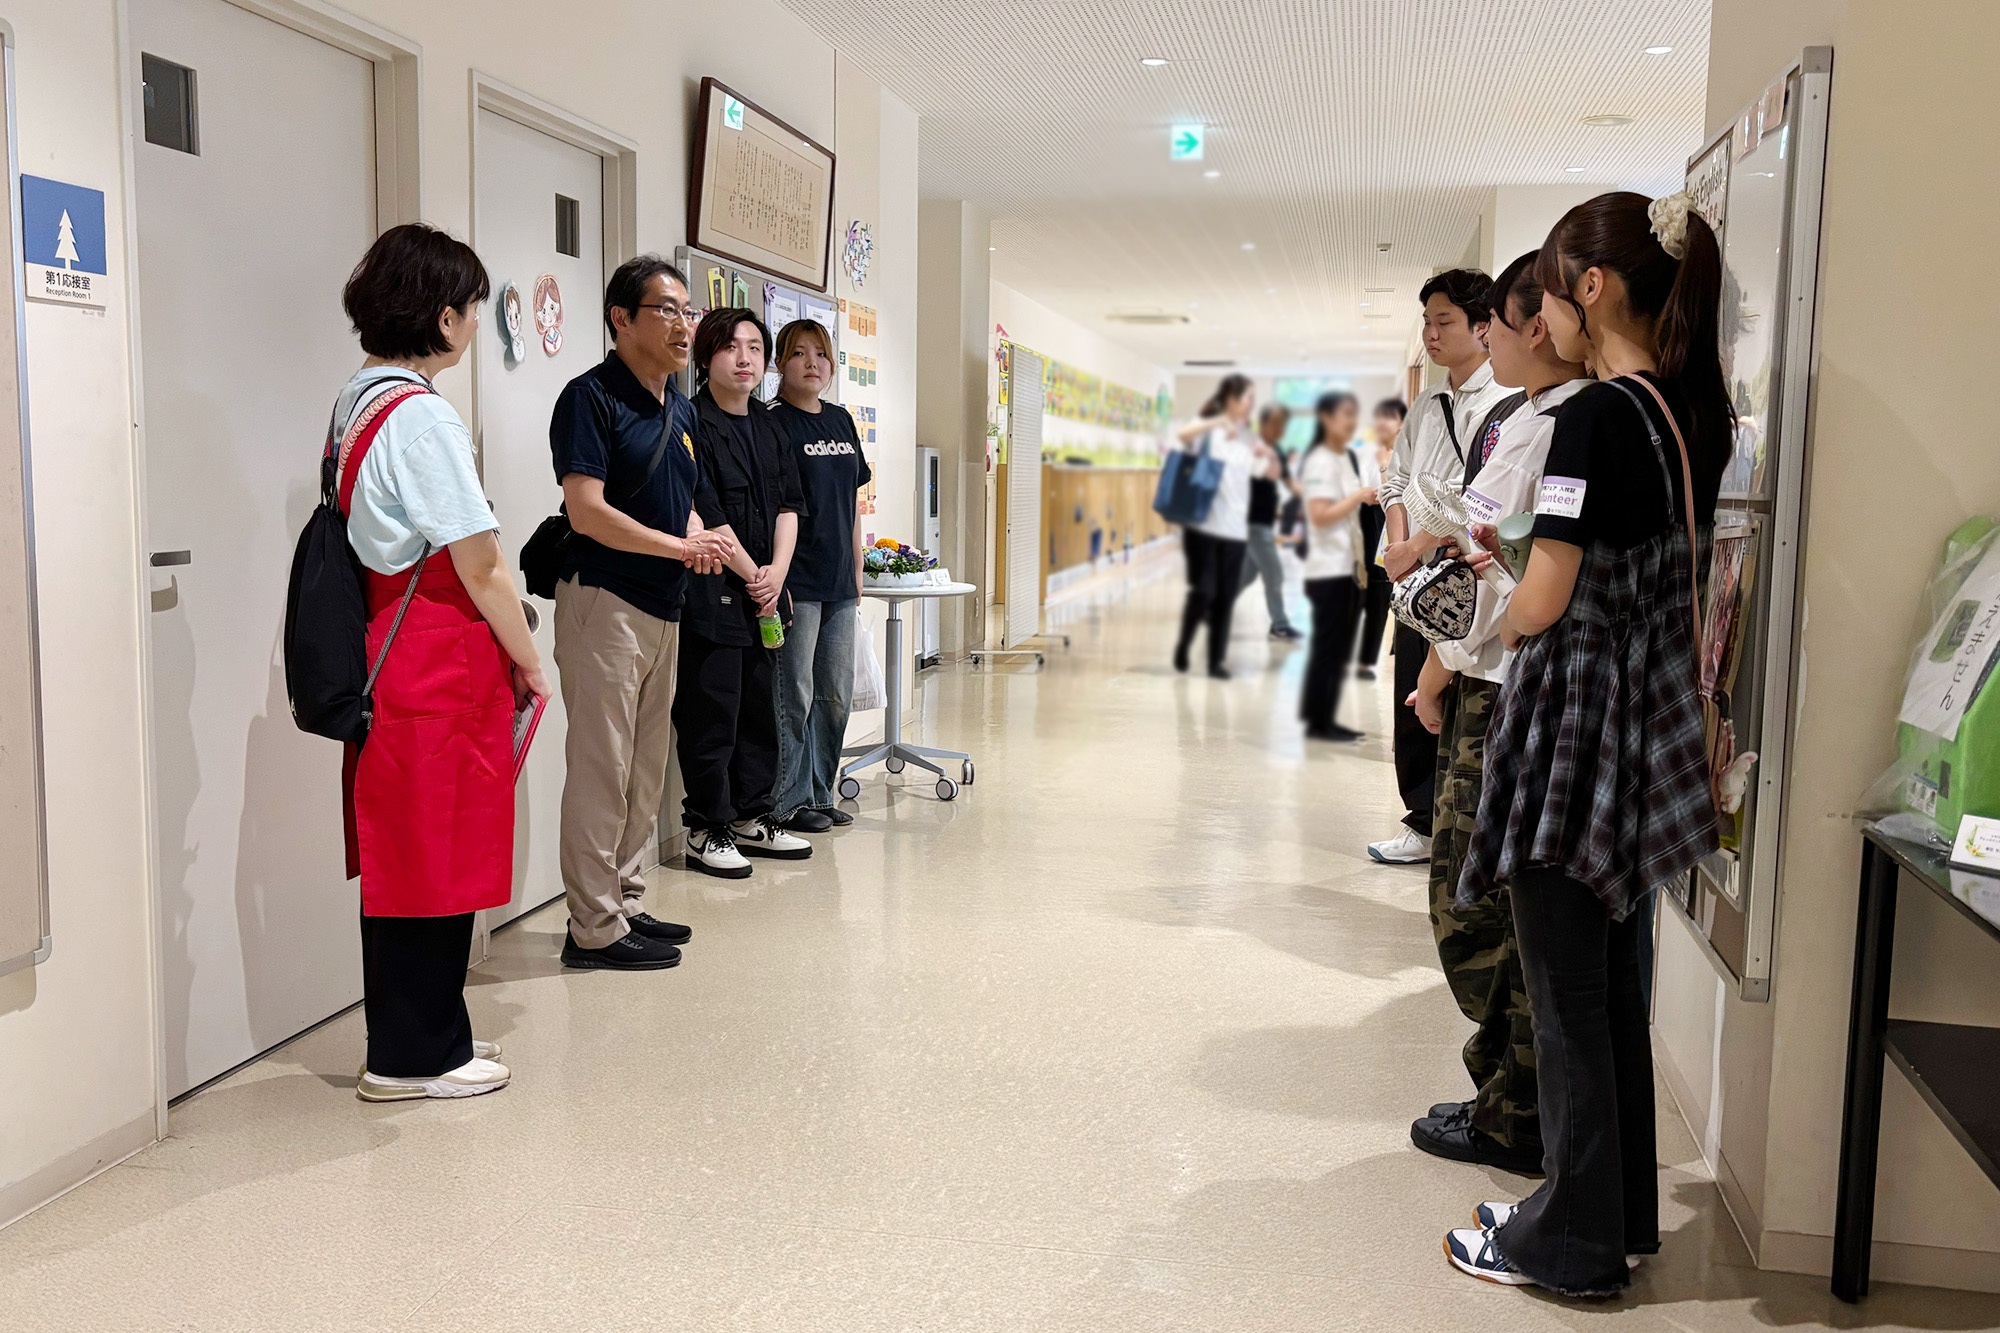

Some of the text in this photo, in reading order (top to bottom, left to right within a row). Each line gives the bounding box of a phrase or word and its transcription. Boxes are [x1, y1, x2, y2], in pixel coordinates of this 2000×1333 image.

[45, 270, 91, 290] 第1応接室
[46, 287, 71, 297] Reception
[72, 291, 87, 299] Room
[804, 439, 855, 456] adidas
[1939, 594, 2000, 711] えません
